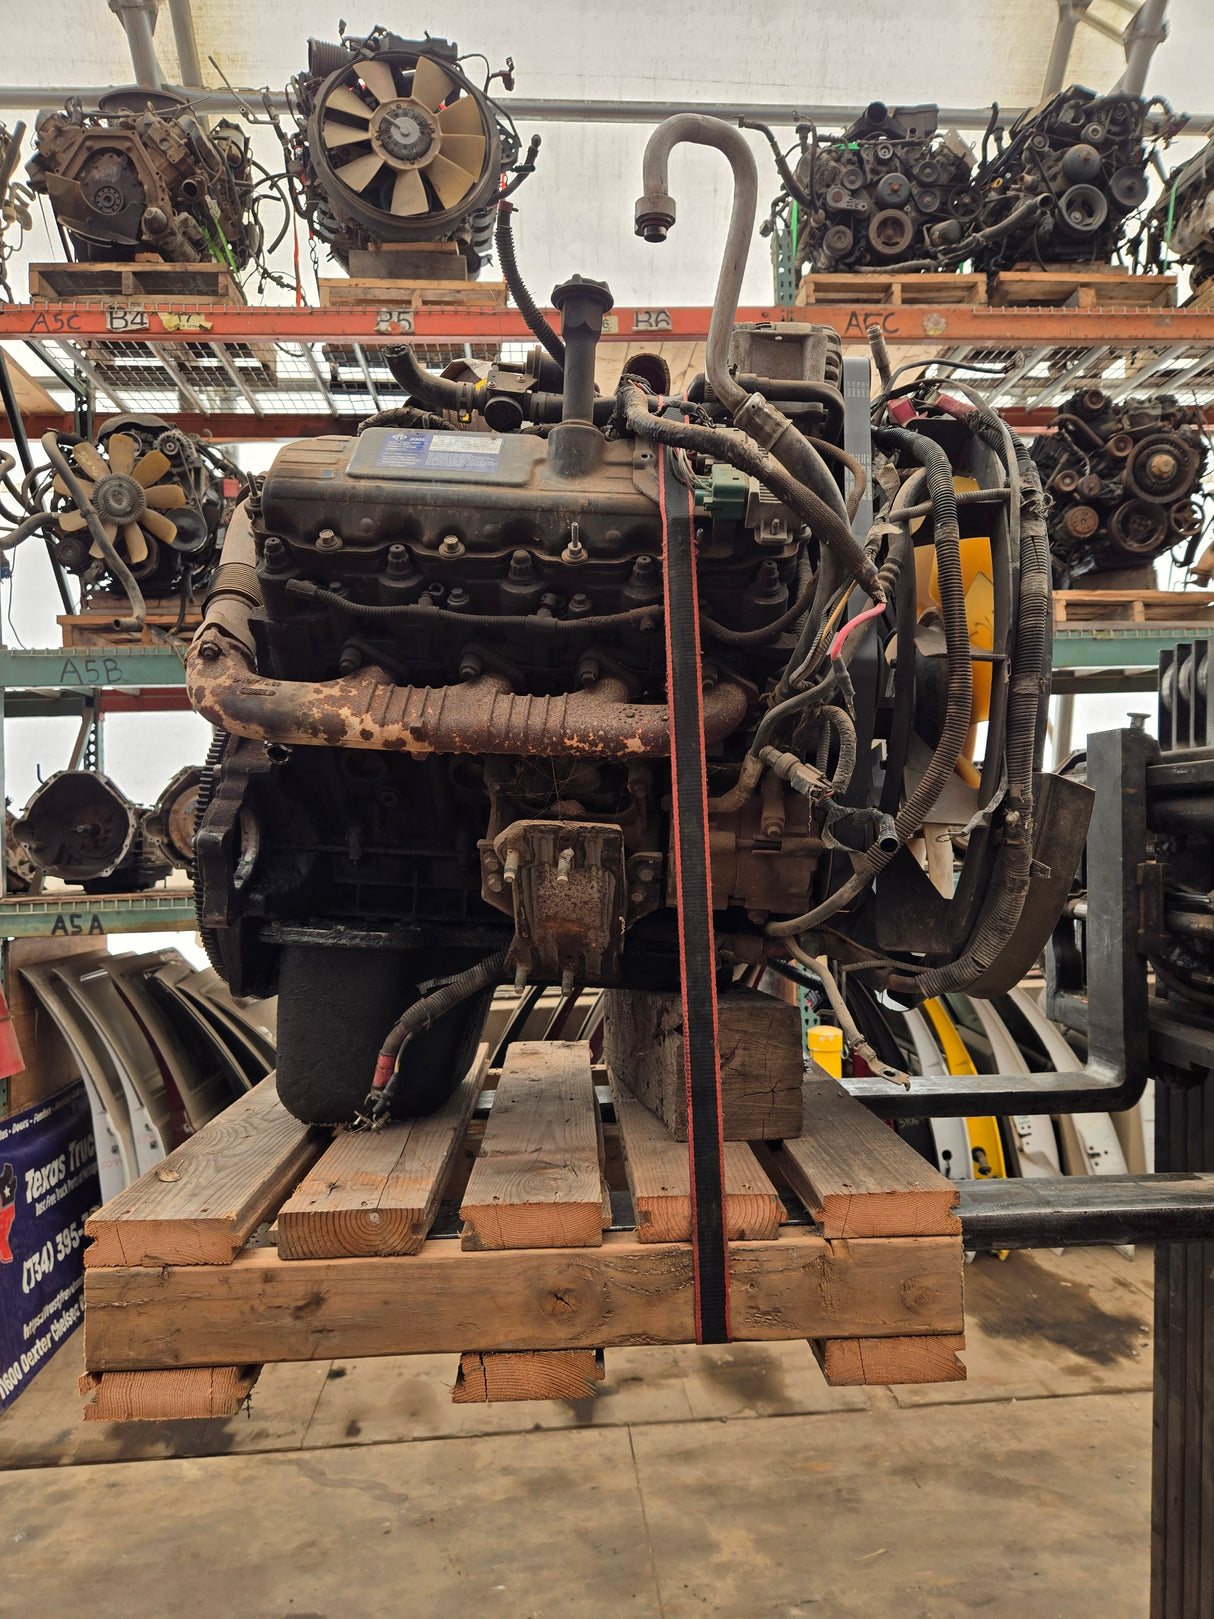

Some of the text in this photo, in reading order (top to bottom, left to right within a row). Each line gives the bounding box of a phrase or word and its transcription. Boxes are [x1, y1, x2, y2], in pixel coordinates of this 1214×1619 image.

[29, 312, 82, 333] A5C
[109, 306, 147, 329] B4
[60, 658, 123, 685] A5B
[51, 914, 105, 936] A5A
[25, 1153, 66, 1204] Texas
[68, 1134, 95, 1172] Truc
[22, 1241, 54, 1294] (734)
[20, 1332, 52, 1374] Dexter
[50, 1303, 80, 1341] Chelsea
